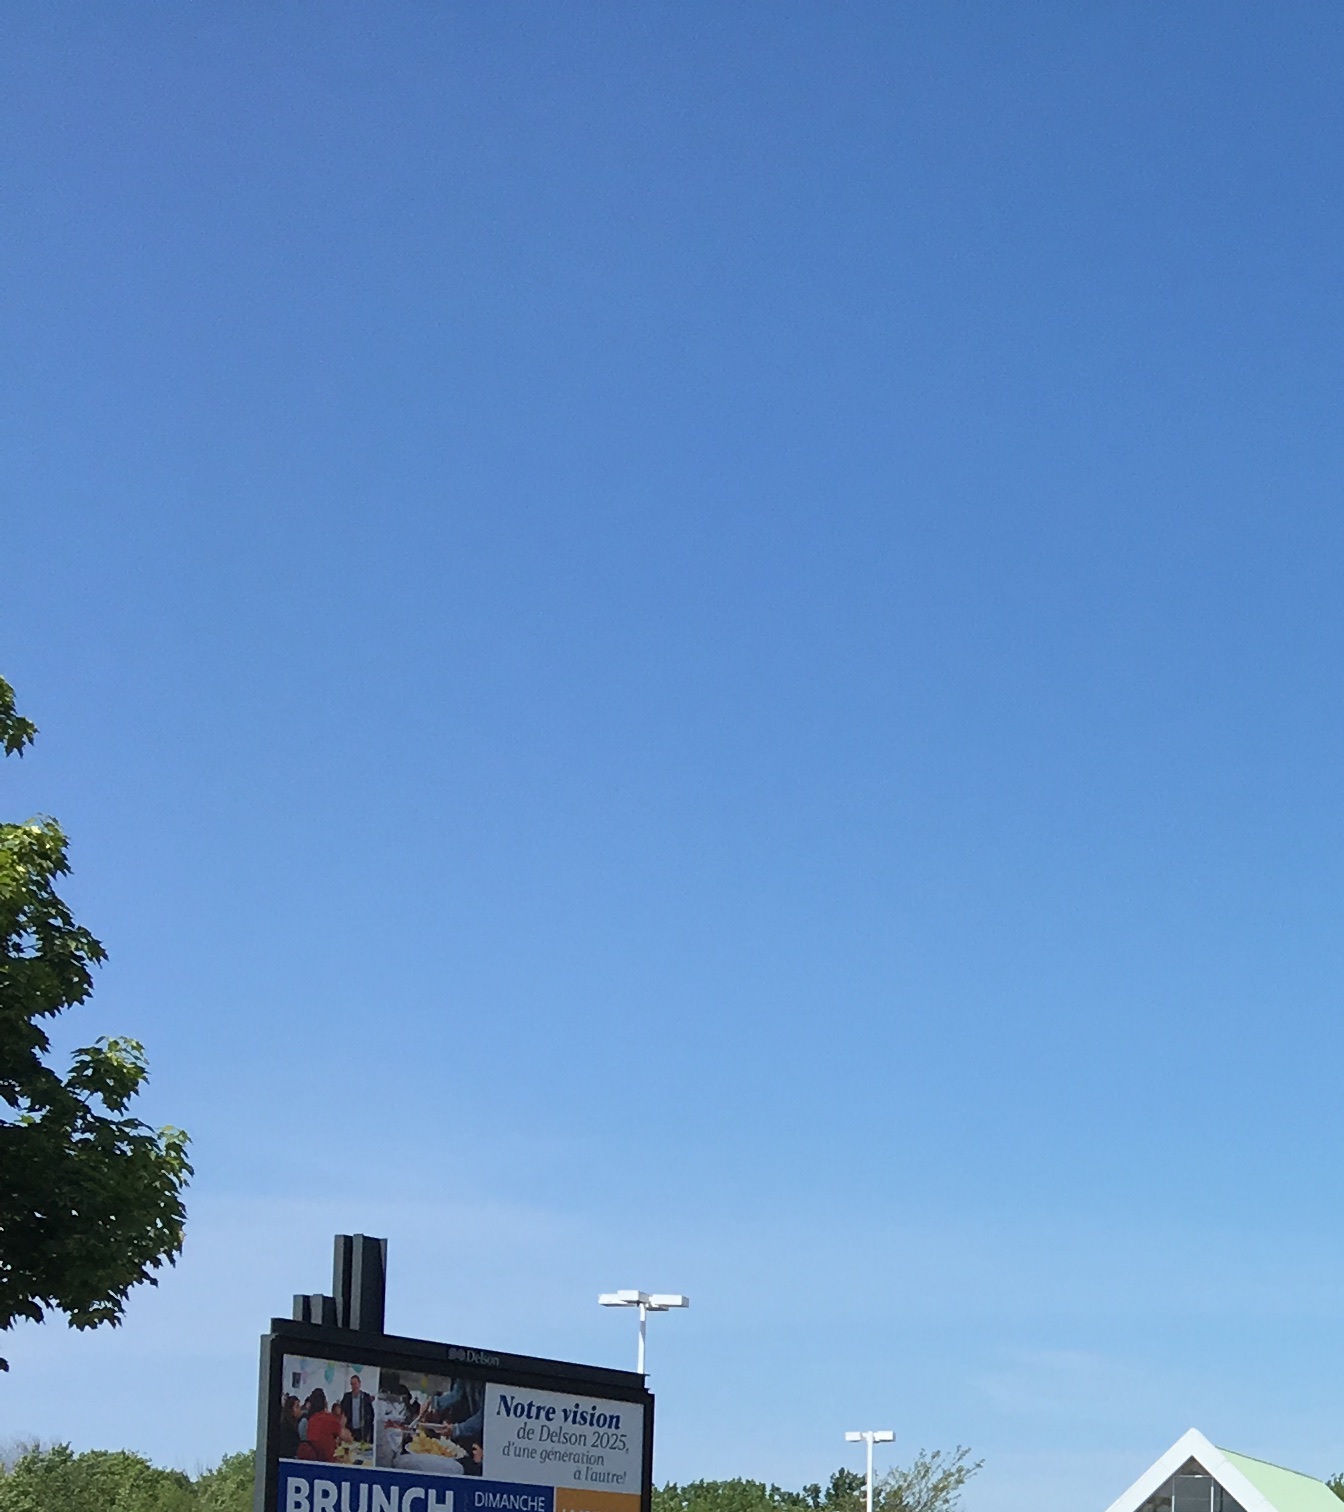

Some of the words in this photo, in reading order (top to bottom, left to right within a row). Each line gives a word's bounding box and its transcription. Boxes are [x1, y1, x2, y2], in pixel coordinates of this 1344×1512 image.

[496, 1394, 556, 1422] Notre
[561, 1402, 621, 1430] vision
[517, 1421, 535, 1440] de
[539, 1424, 587, 1447] Delson
[591, 1431, 629, 1454] 2025,
[502, 1441, 538, 1460] d'une
[539, 1448, 605, 1467] génération
[585, 1467, 627, 1485] l'autre!
[474, 1491, 546, 1512] DIMANCHE
